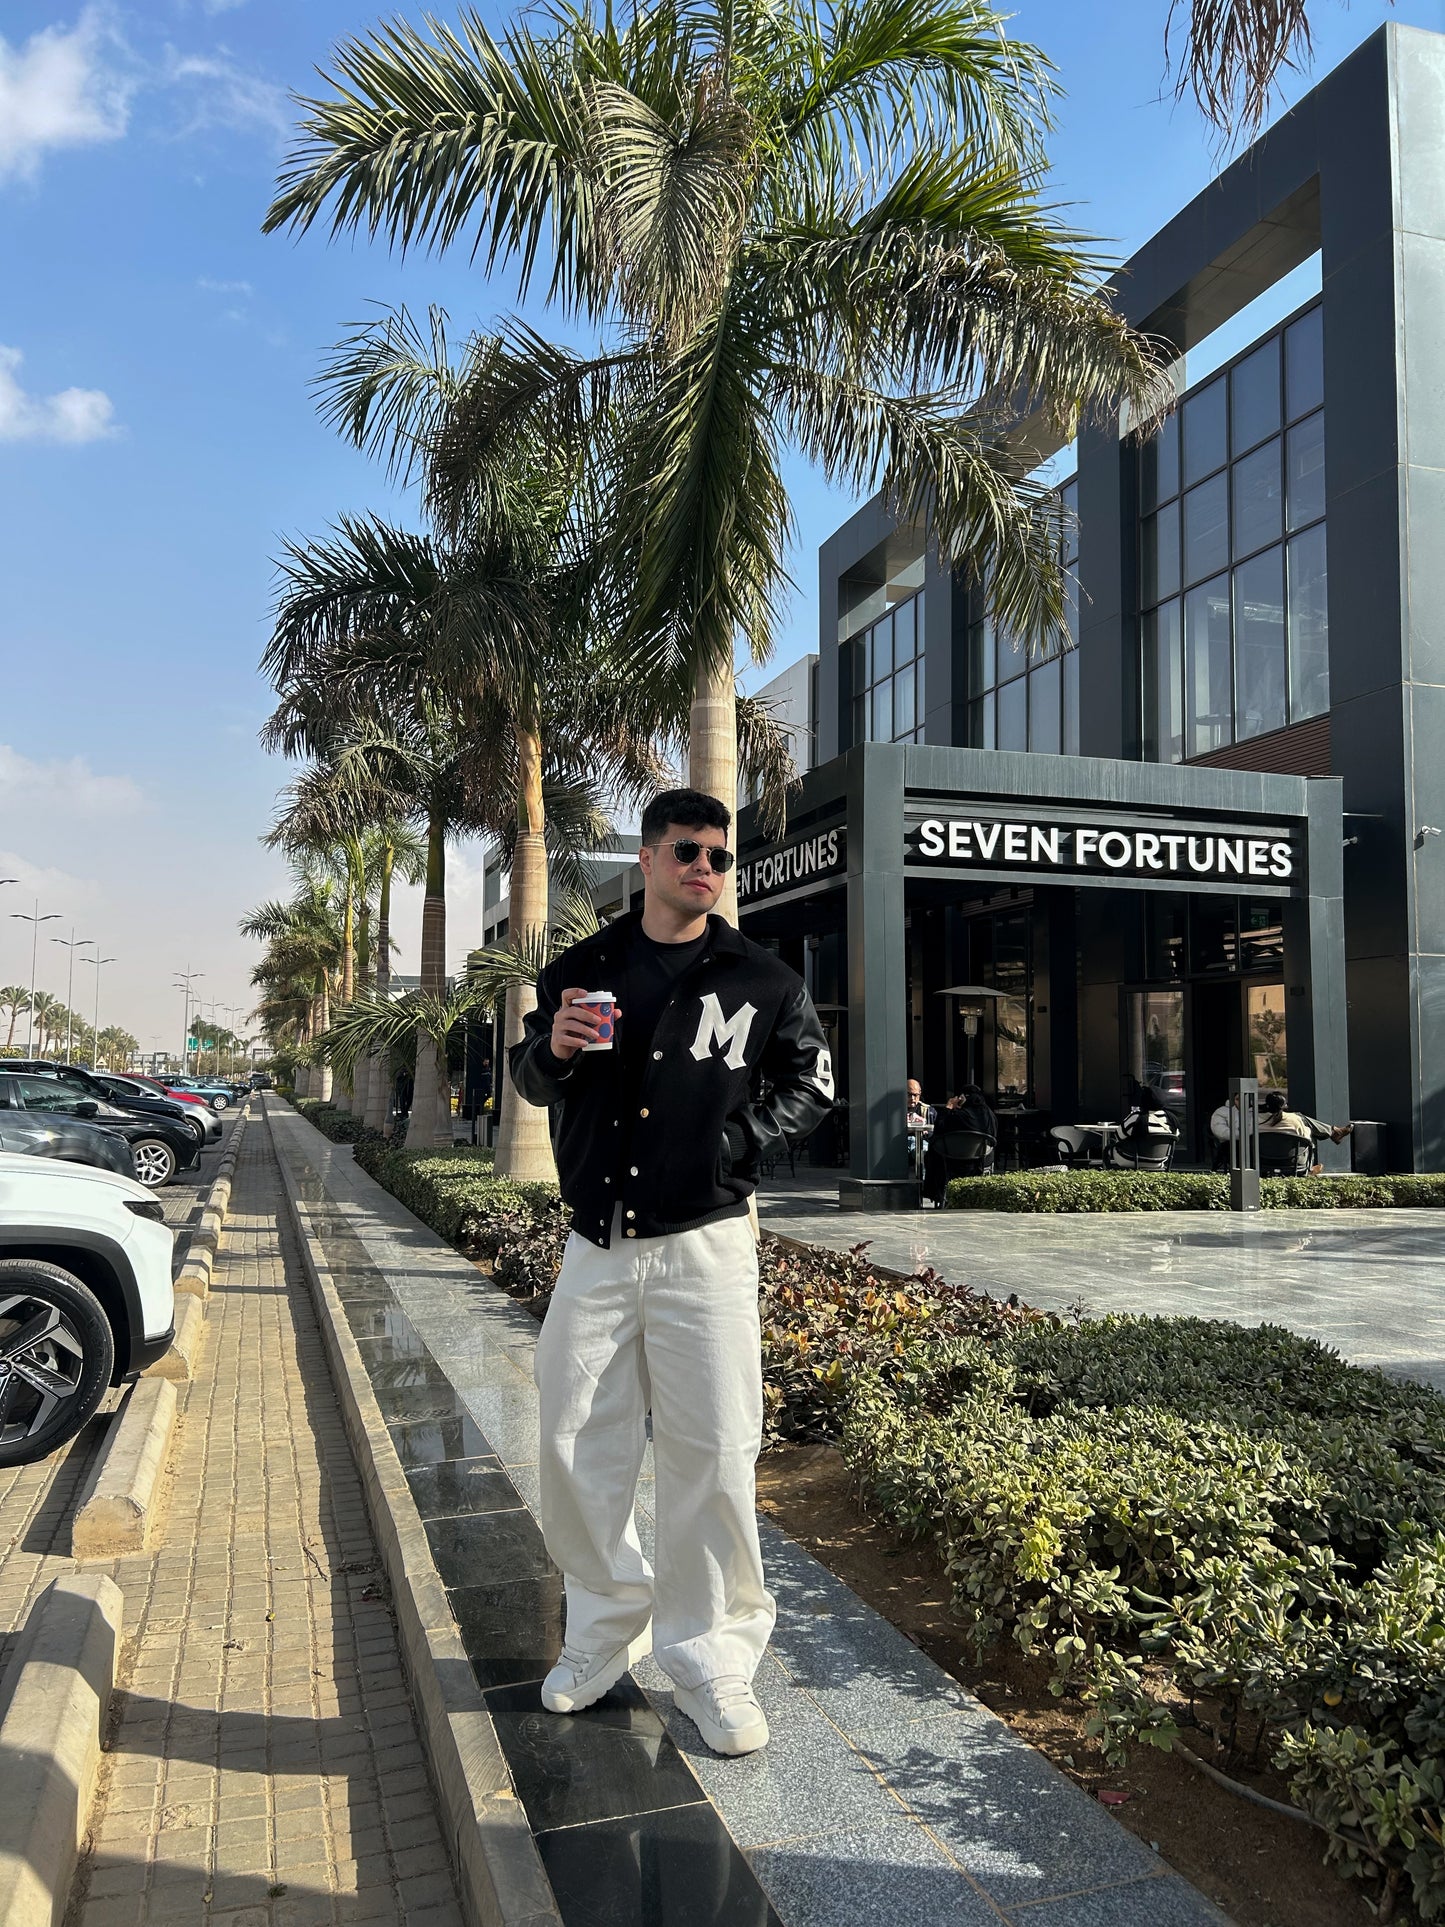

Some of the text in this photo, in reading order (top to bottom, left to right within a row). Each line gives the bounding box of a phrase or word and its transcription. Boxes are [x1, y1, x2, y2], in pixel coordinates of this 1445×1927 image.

[754, 829, 838, 889] FORTUNES
[918, 819, 1293, 878] SEVEN FORTUNES
[689, 992, 758, 1071] M
